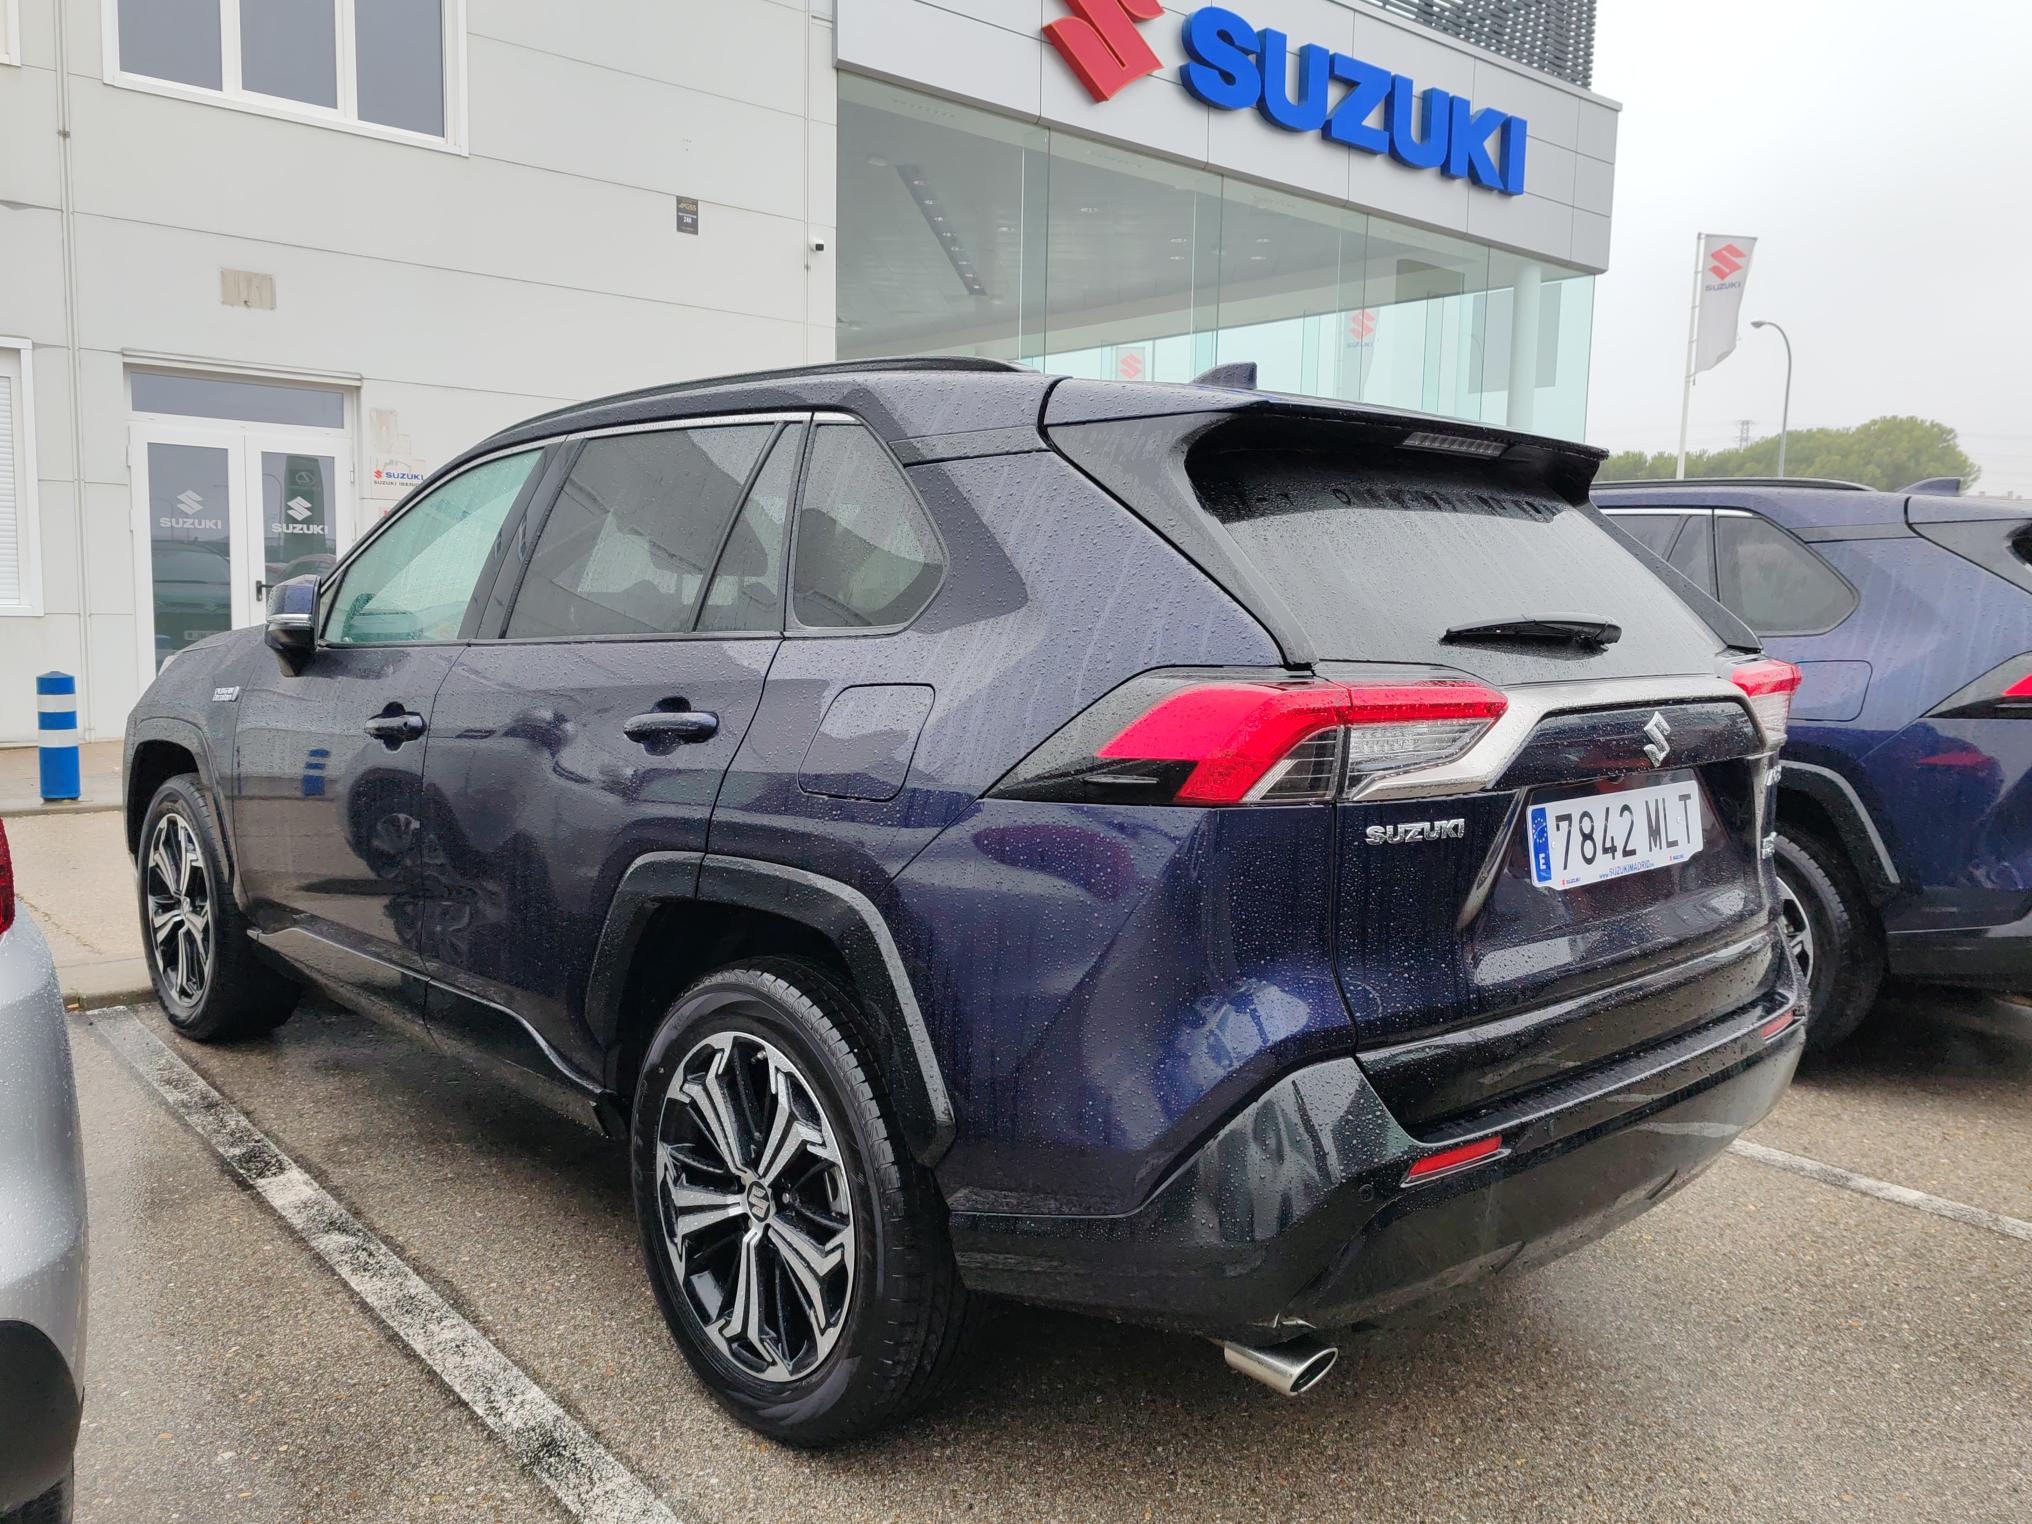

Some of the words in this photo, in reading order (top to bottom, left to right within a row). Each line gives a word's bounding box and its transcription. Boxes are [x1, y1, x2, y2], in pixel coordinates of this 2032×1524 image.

[1180, 6, 1527, 196] SUZUKI
[1704, 281, 1742, 292] SUZUKI
[385, 471, 424, 481] SUZUKI
[159, 516, 222, 530] SUZUKI
[271, 522, 328, 535] SUZUKI
[1364, 818, 1465, 846] SUZUKI
[1555, 803, 1637, 871] 7842
[1645, 793, 1692, 853] MLT
[1538, 853, 1547, 870] E
